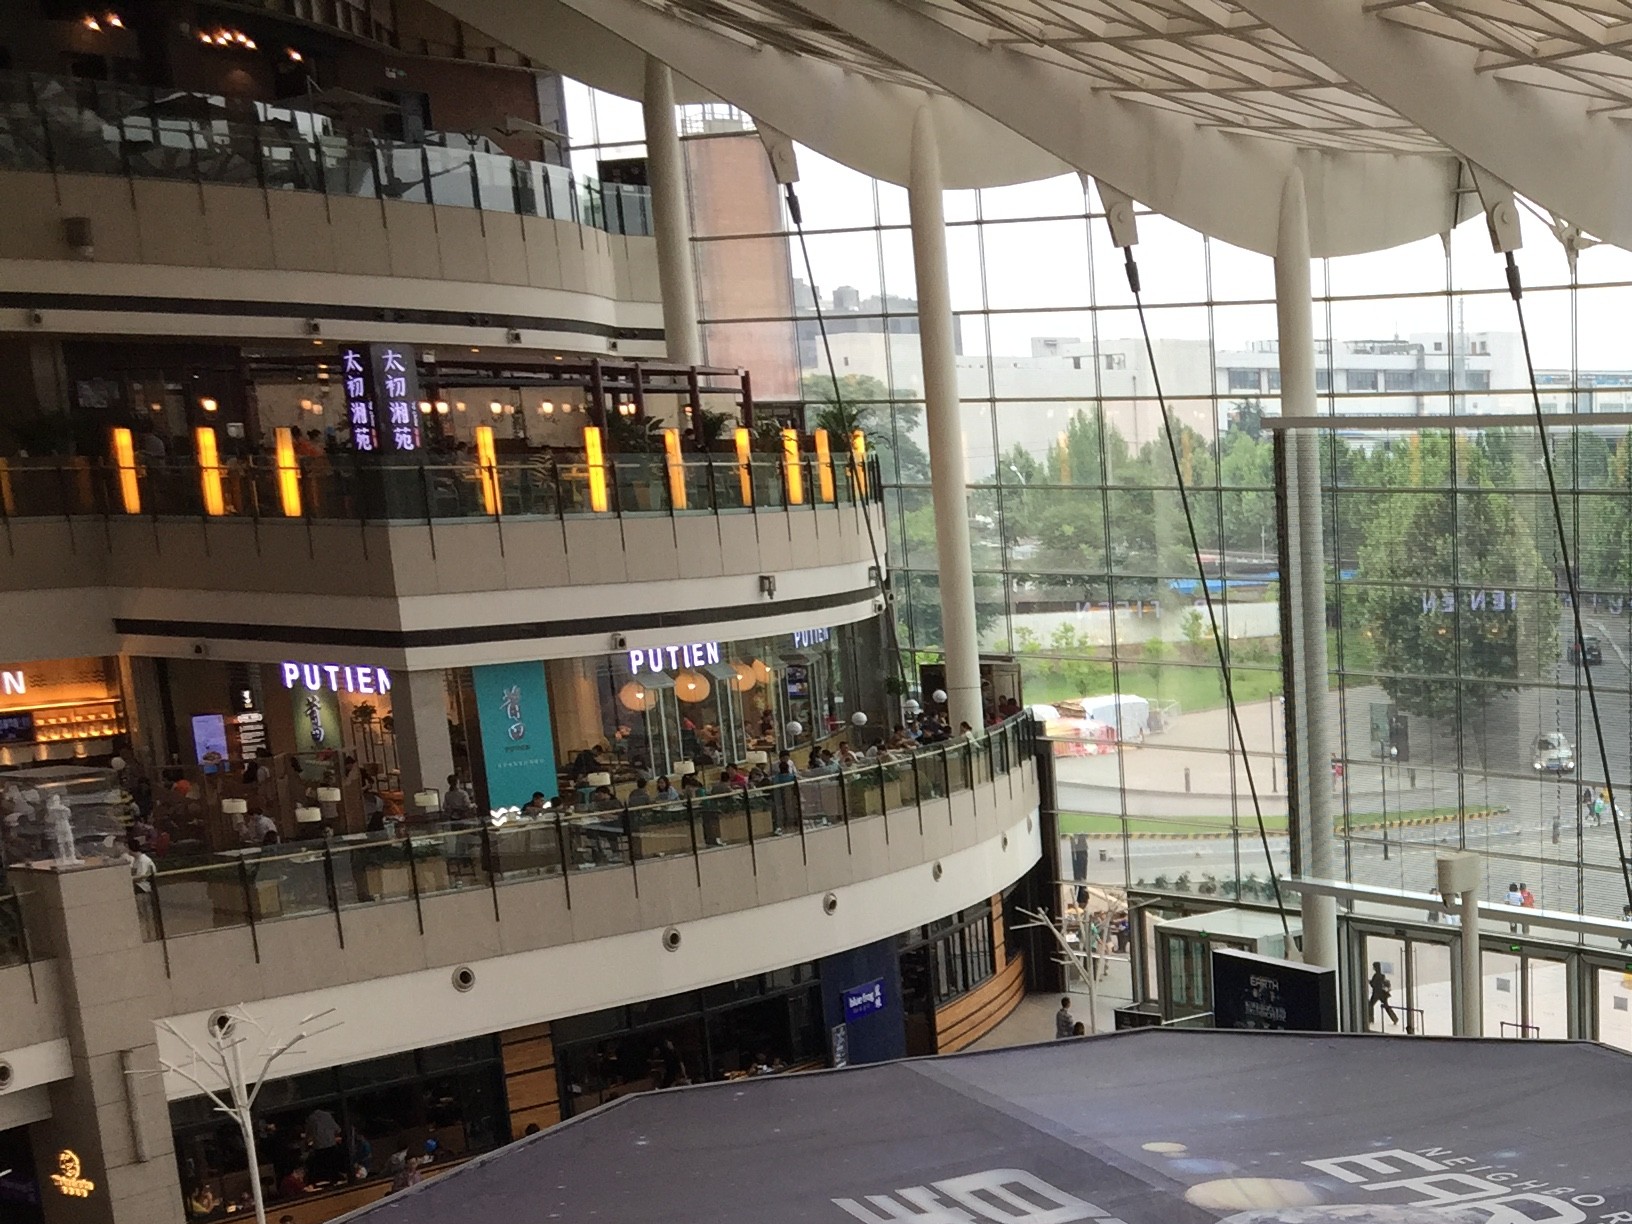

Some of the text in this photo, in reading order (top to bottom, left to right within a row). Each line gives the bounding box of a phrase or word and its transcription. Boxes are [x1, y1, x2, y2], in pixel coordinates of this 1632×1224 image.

[343, 349, 372, 451] 太初湘苑
[381, 349, 414, 451] 太初湘苑
[284, 662, 392, 694] PUTIEN
[630, 642, 720, 674] PUTIEN
